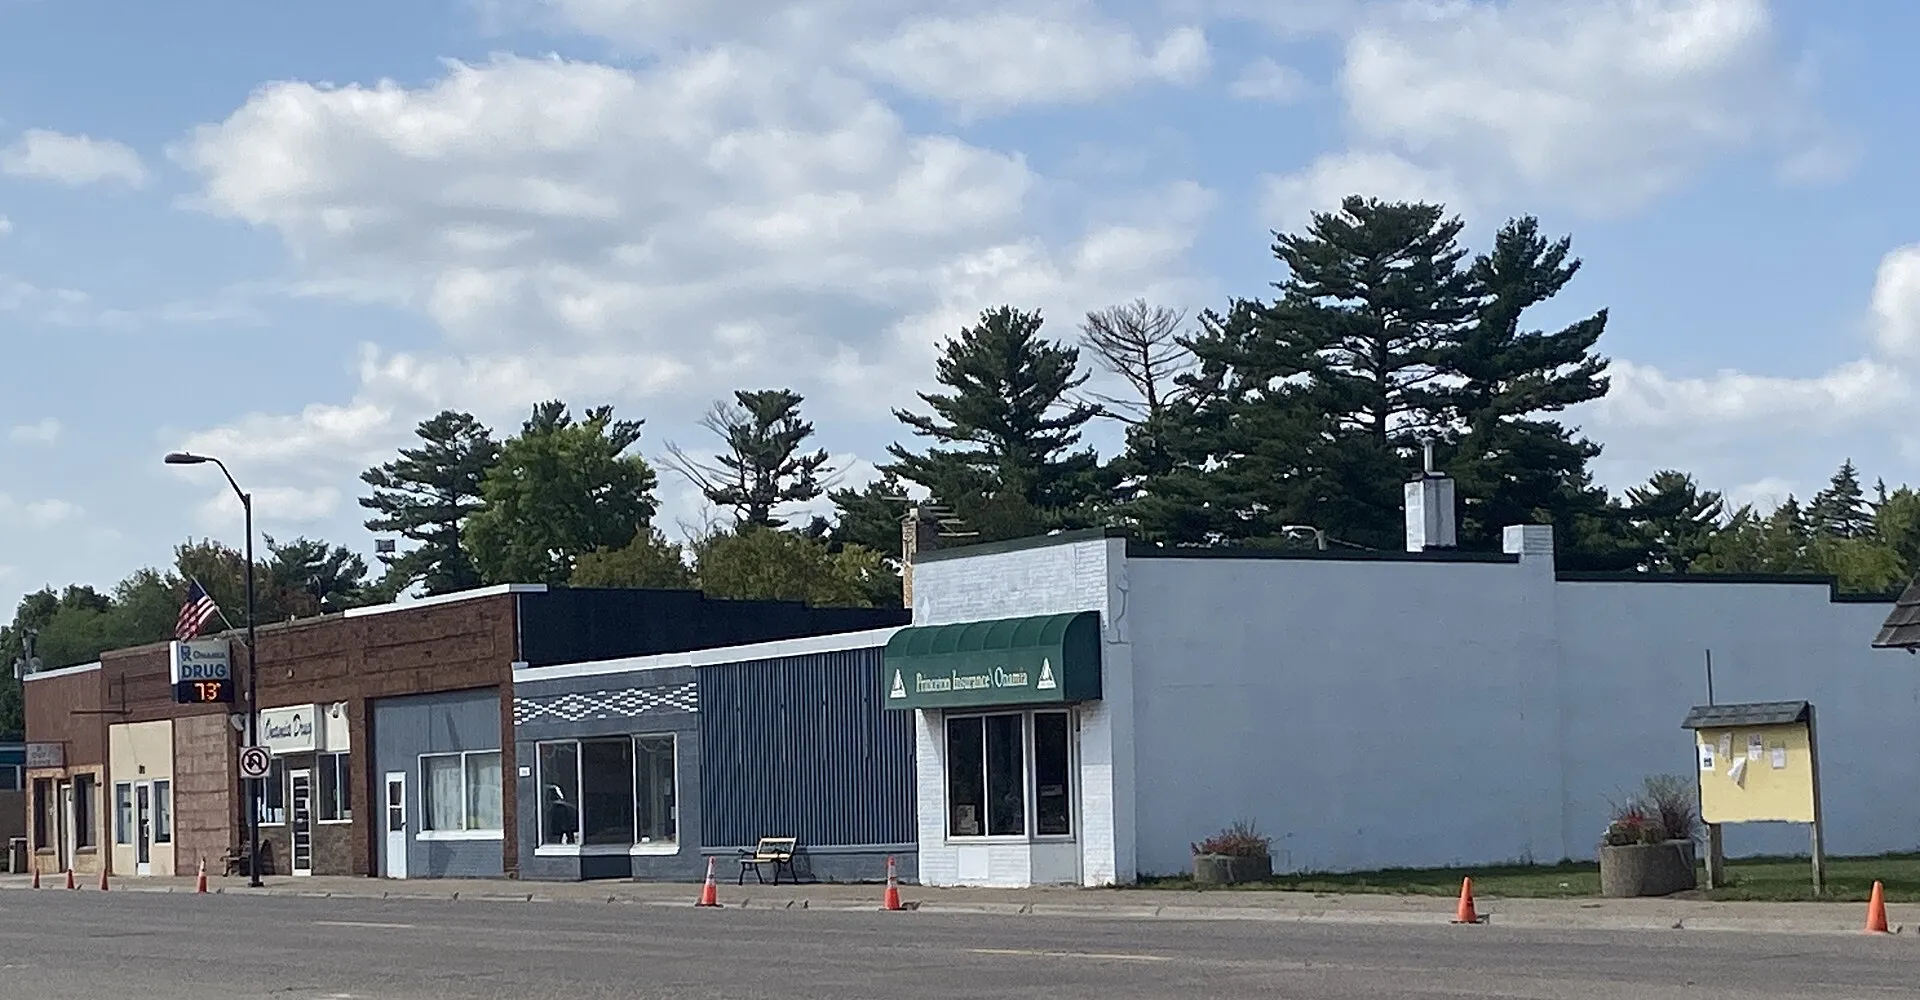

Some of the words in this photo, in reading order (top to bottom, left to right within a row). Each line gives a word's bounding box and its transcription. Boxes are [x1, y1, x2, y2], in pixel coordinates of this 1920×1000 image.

[181, 664, 226, 678] DRUG
[952, 669, 990, 691] Insurance
[994, 666, 1028, 688] Onamia
